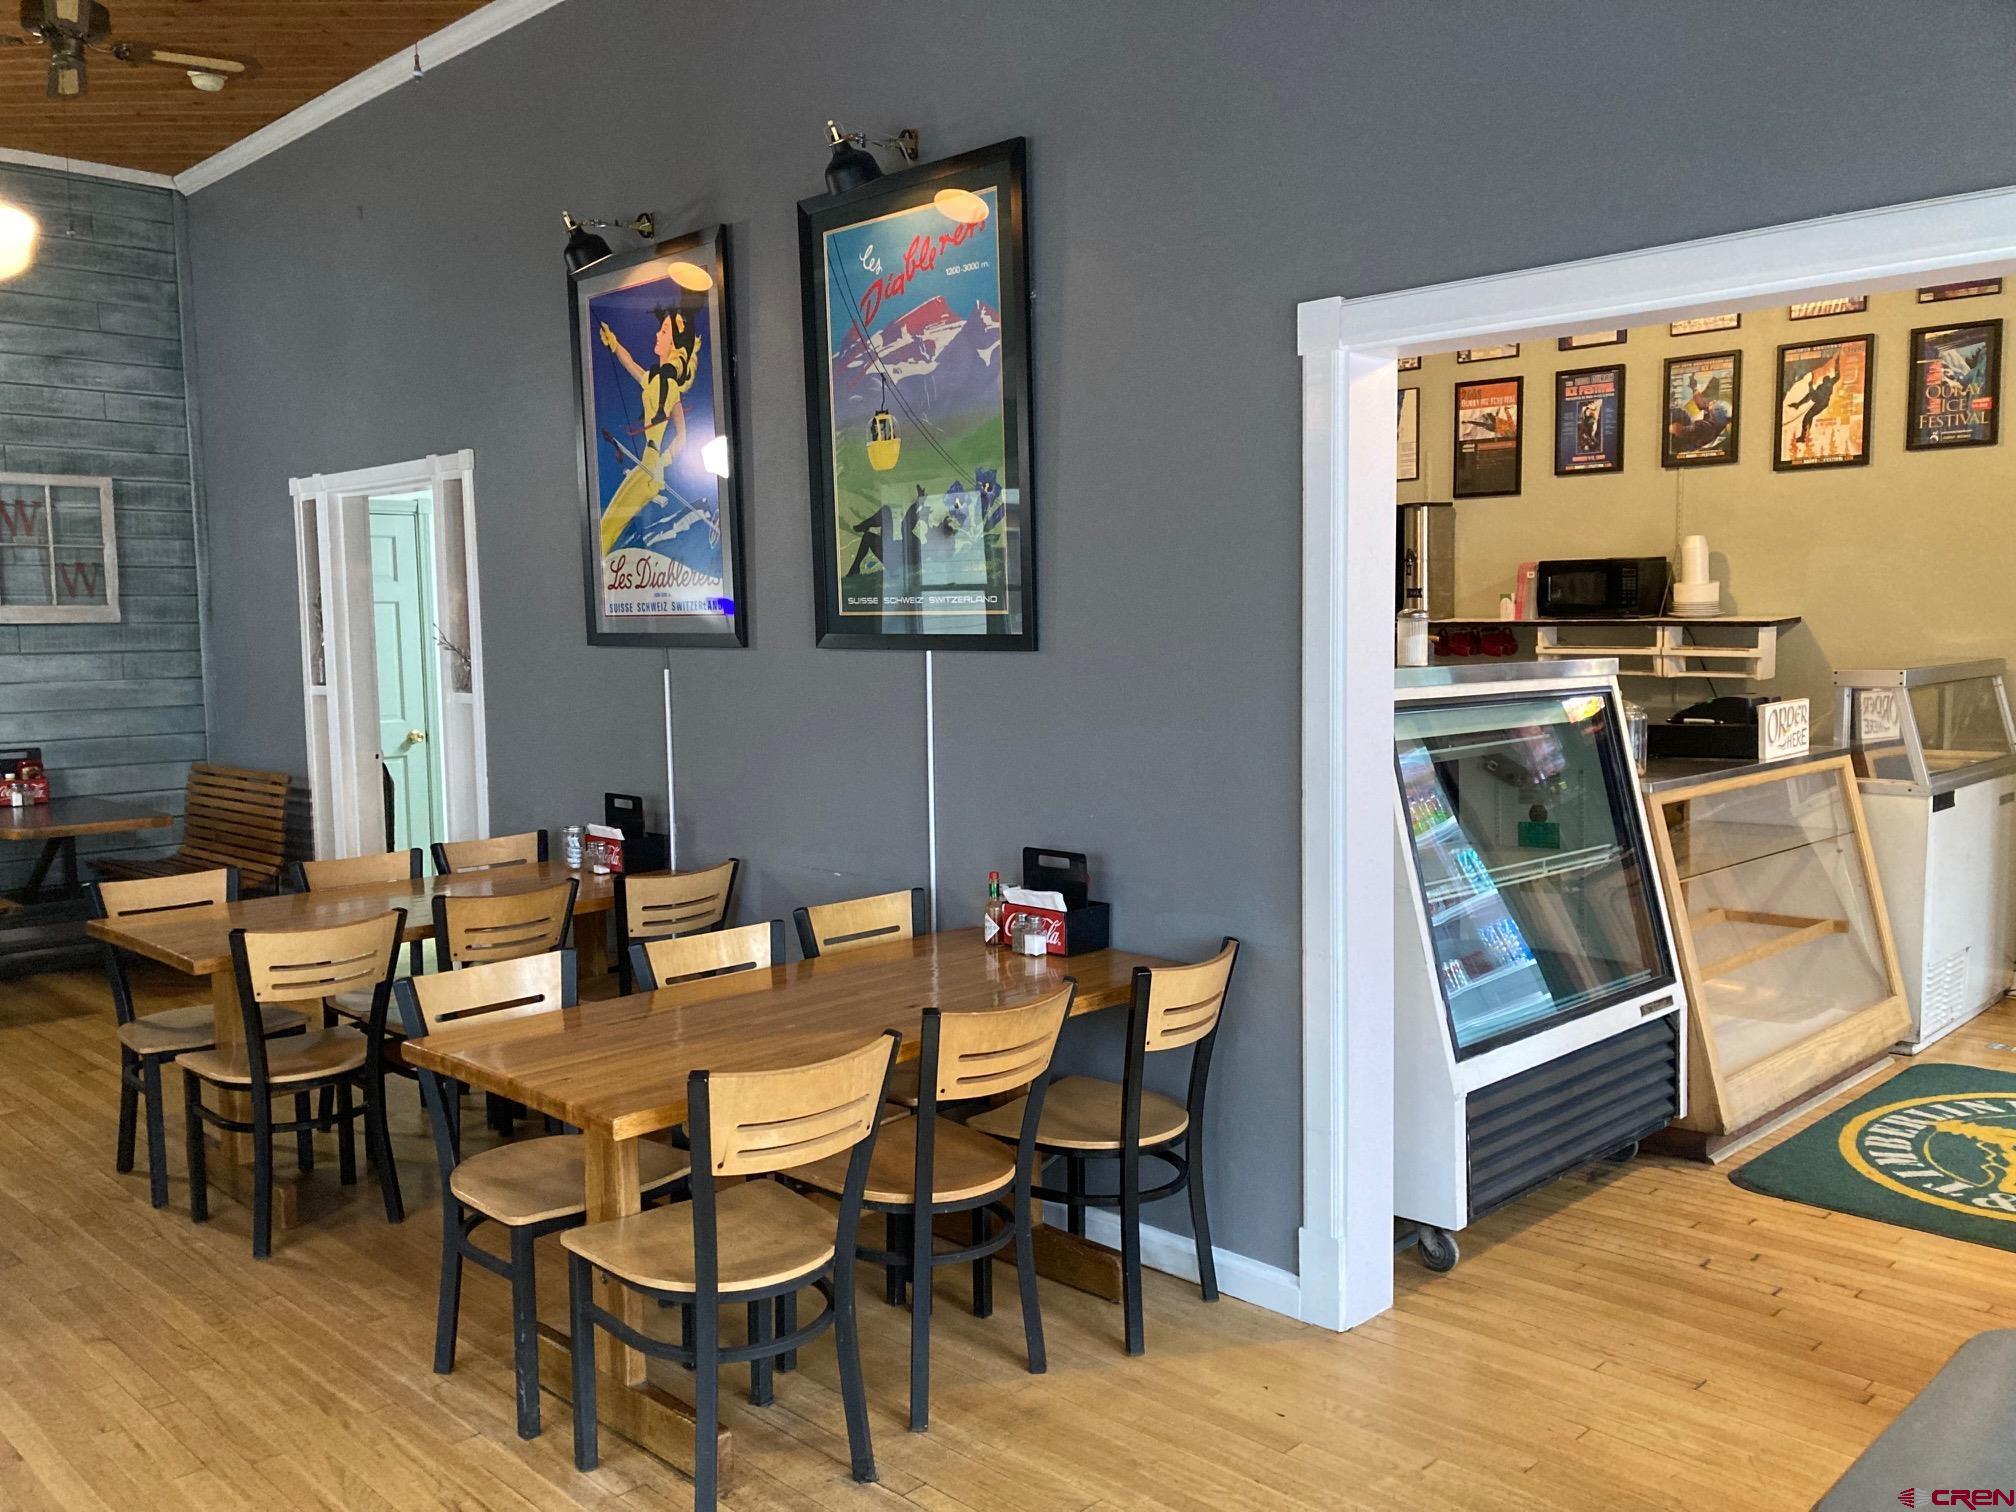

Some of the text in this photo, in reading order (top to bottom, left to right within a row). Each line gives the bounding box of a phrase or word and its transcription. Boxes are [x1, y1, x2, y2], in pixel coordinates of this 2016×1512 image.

[859, 244, 884, 275] les
[1925, 383, 1982, 399] OURAY
[1941, 398, 1968, 413] ICE
[1919, 410, 1990, 429] FESTIVAL
[607, 554, 633, 590] Les
[609, 601, 634, 613] SUISSE
[637, 601, 667, 613] SCHWEIZ
[847, 594, 998, 605] SUISSE SCHWEIZ SWITZERLAND
[1768, 704, 1807, 744] ORDER
[1781, 727, 1807, 749] HERE
